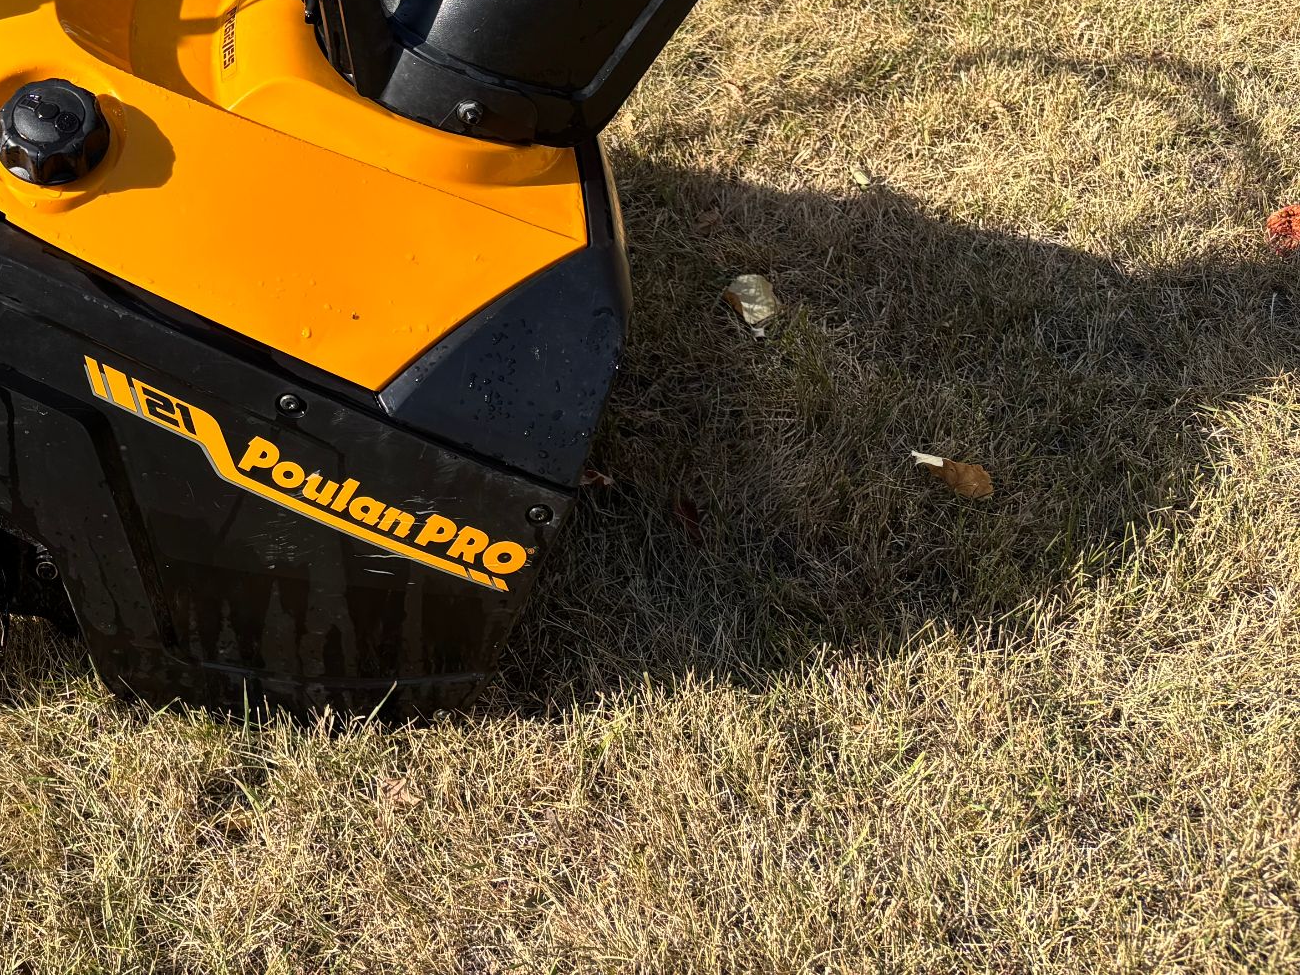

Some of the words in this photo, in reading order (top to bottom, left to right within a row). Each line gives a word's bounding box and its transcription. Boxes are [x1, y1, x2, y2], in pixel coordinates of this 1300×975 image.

[141, 390, 198, 435] 21
[238, 435, 416, 539] Poulan
[414, 514, 528, 574] PRO
